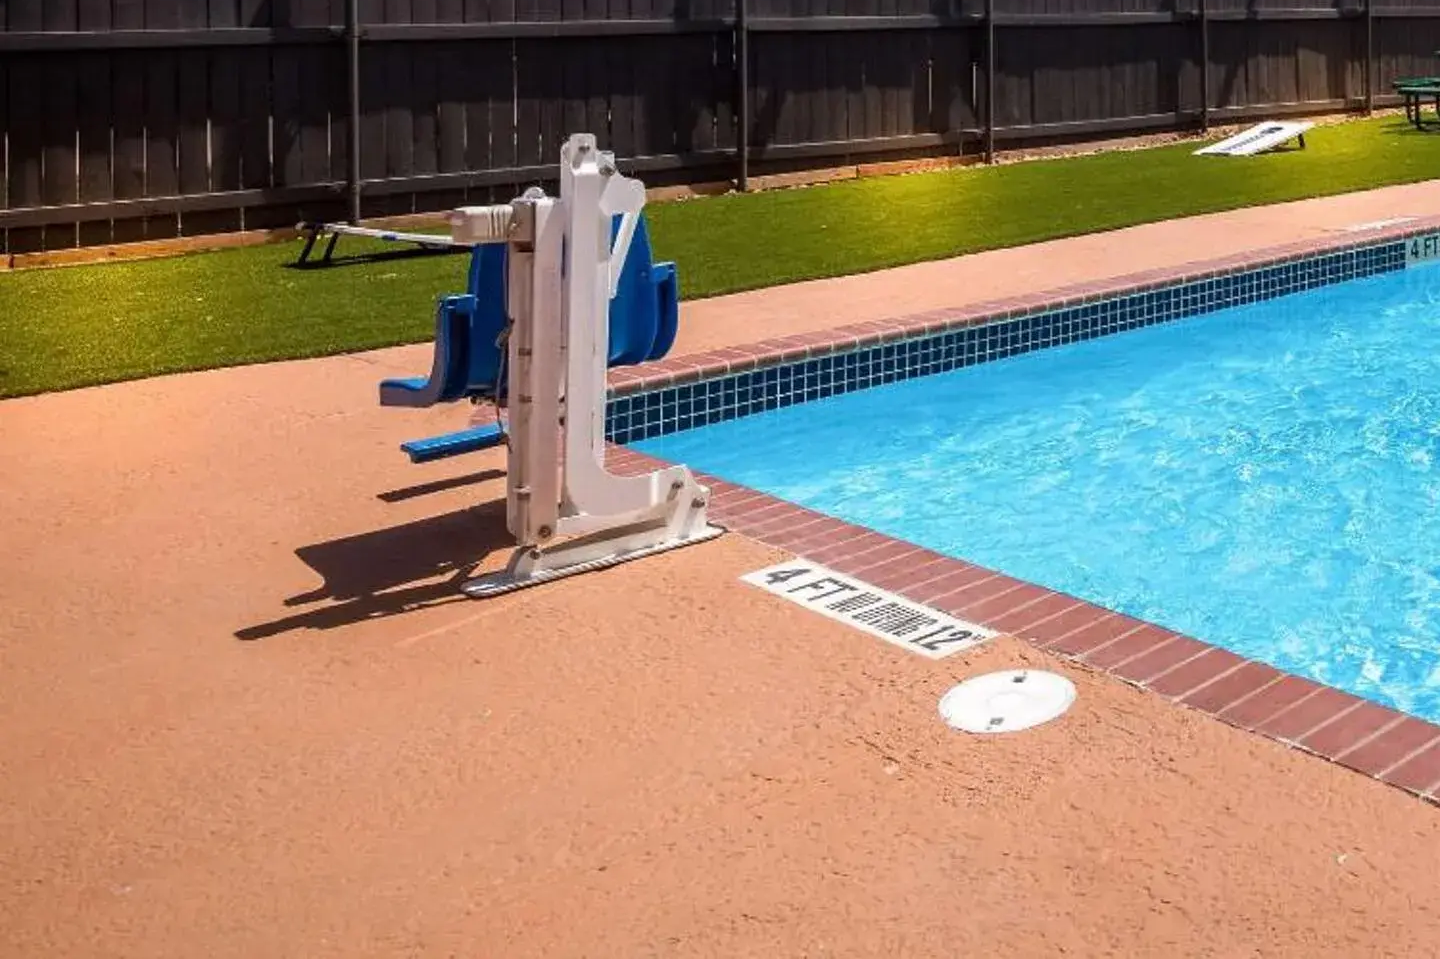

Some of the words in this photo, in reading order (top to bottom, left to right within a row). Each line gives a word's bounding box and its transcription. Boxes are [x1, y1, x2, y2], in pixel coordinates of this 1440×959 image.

[1410, 239, 1418, 258] 4
[1424, 236, 1439, 257] FT
[765, 568, 811, 585] 4
[786, 577, 859, 601] FT
[825, 591, 883, 612] NO
